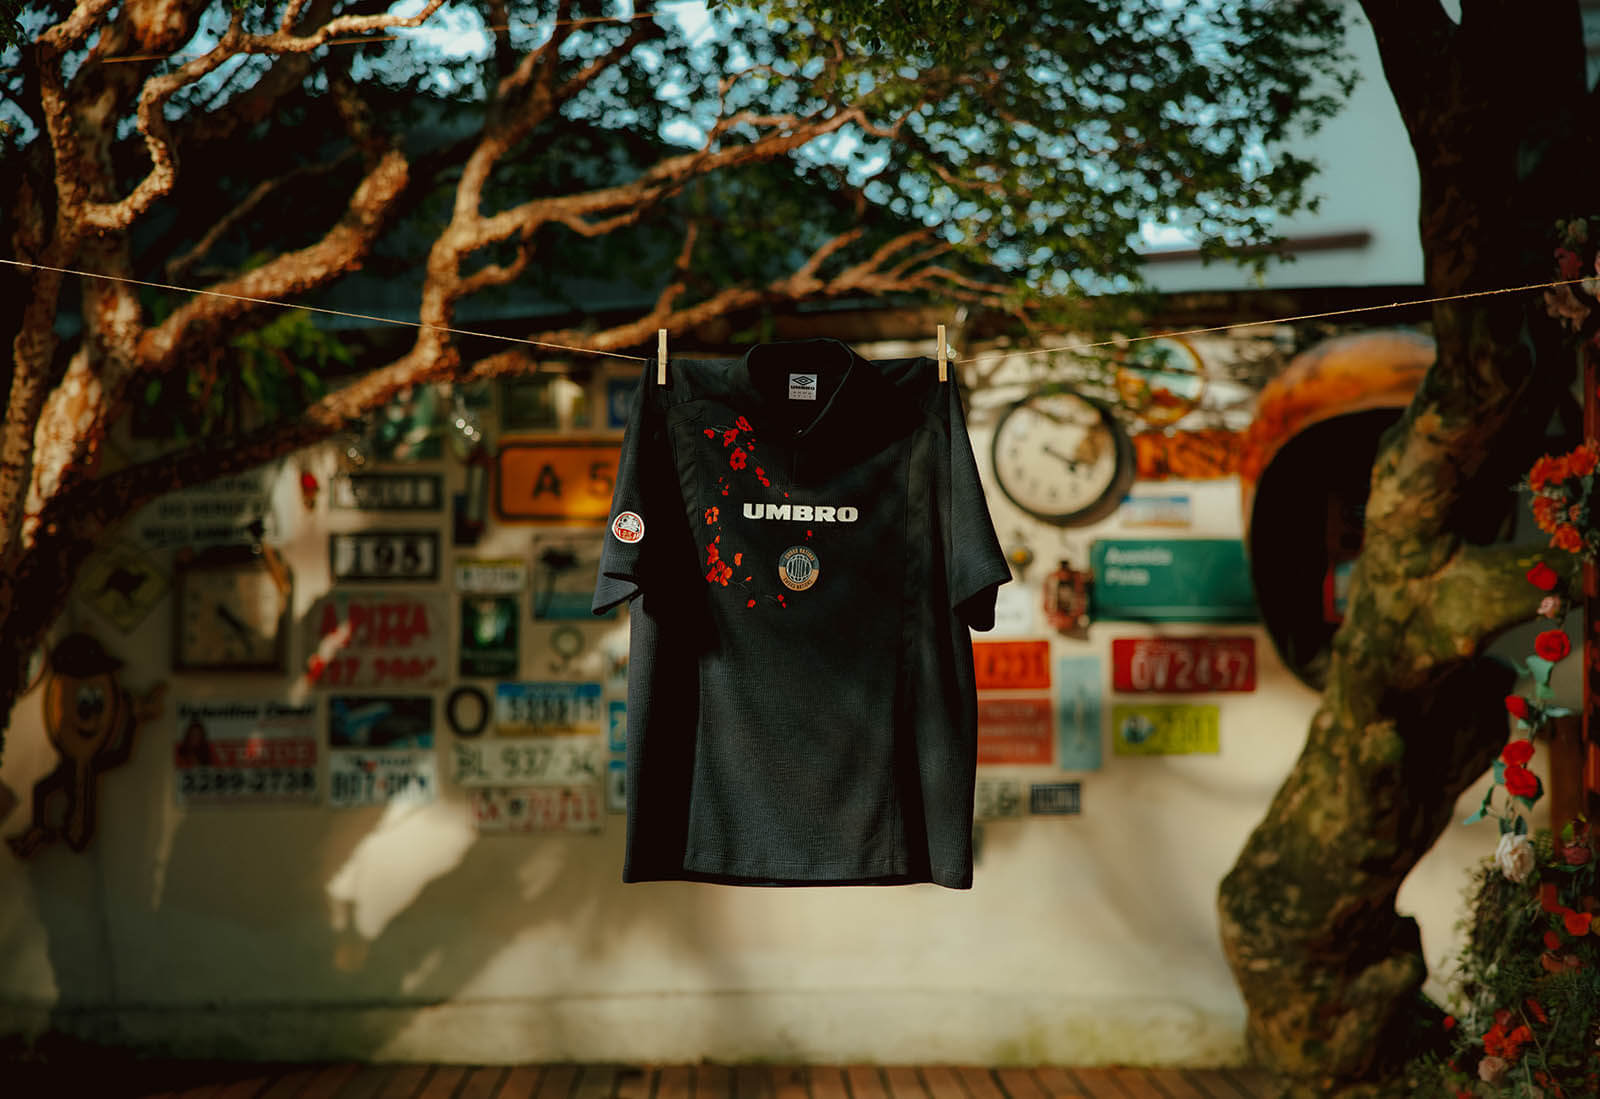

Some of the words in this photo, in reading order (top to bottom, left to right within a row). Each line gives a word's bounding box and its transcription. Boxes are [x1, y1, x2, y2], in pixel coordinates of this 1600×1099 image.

[532, 464, 561, 498] A
[588, 462, 613, 498] 5
[743, 503, 859, 522] UMBRO
